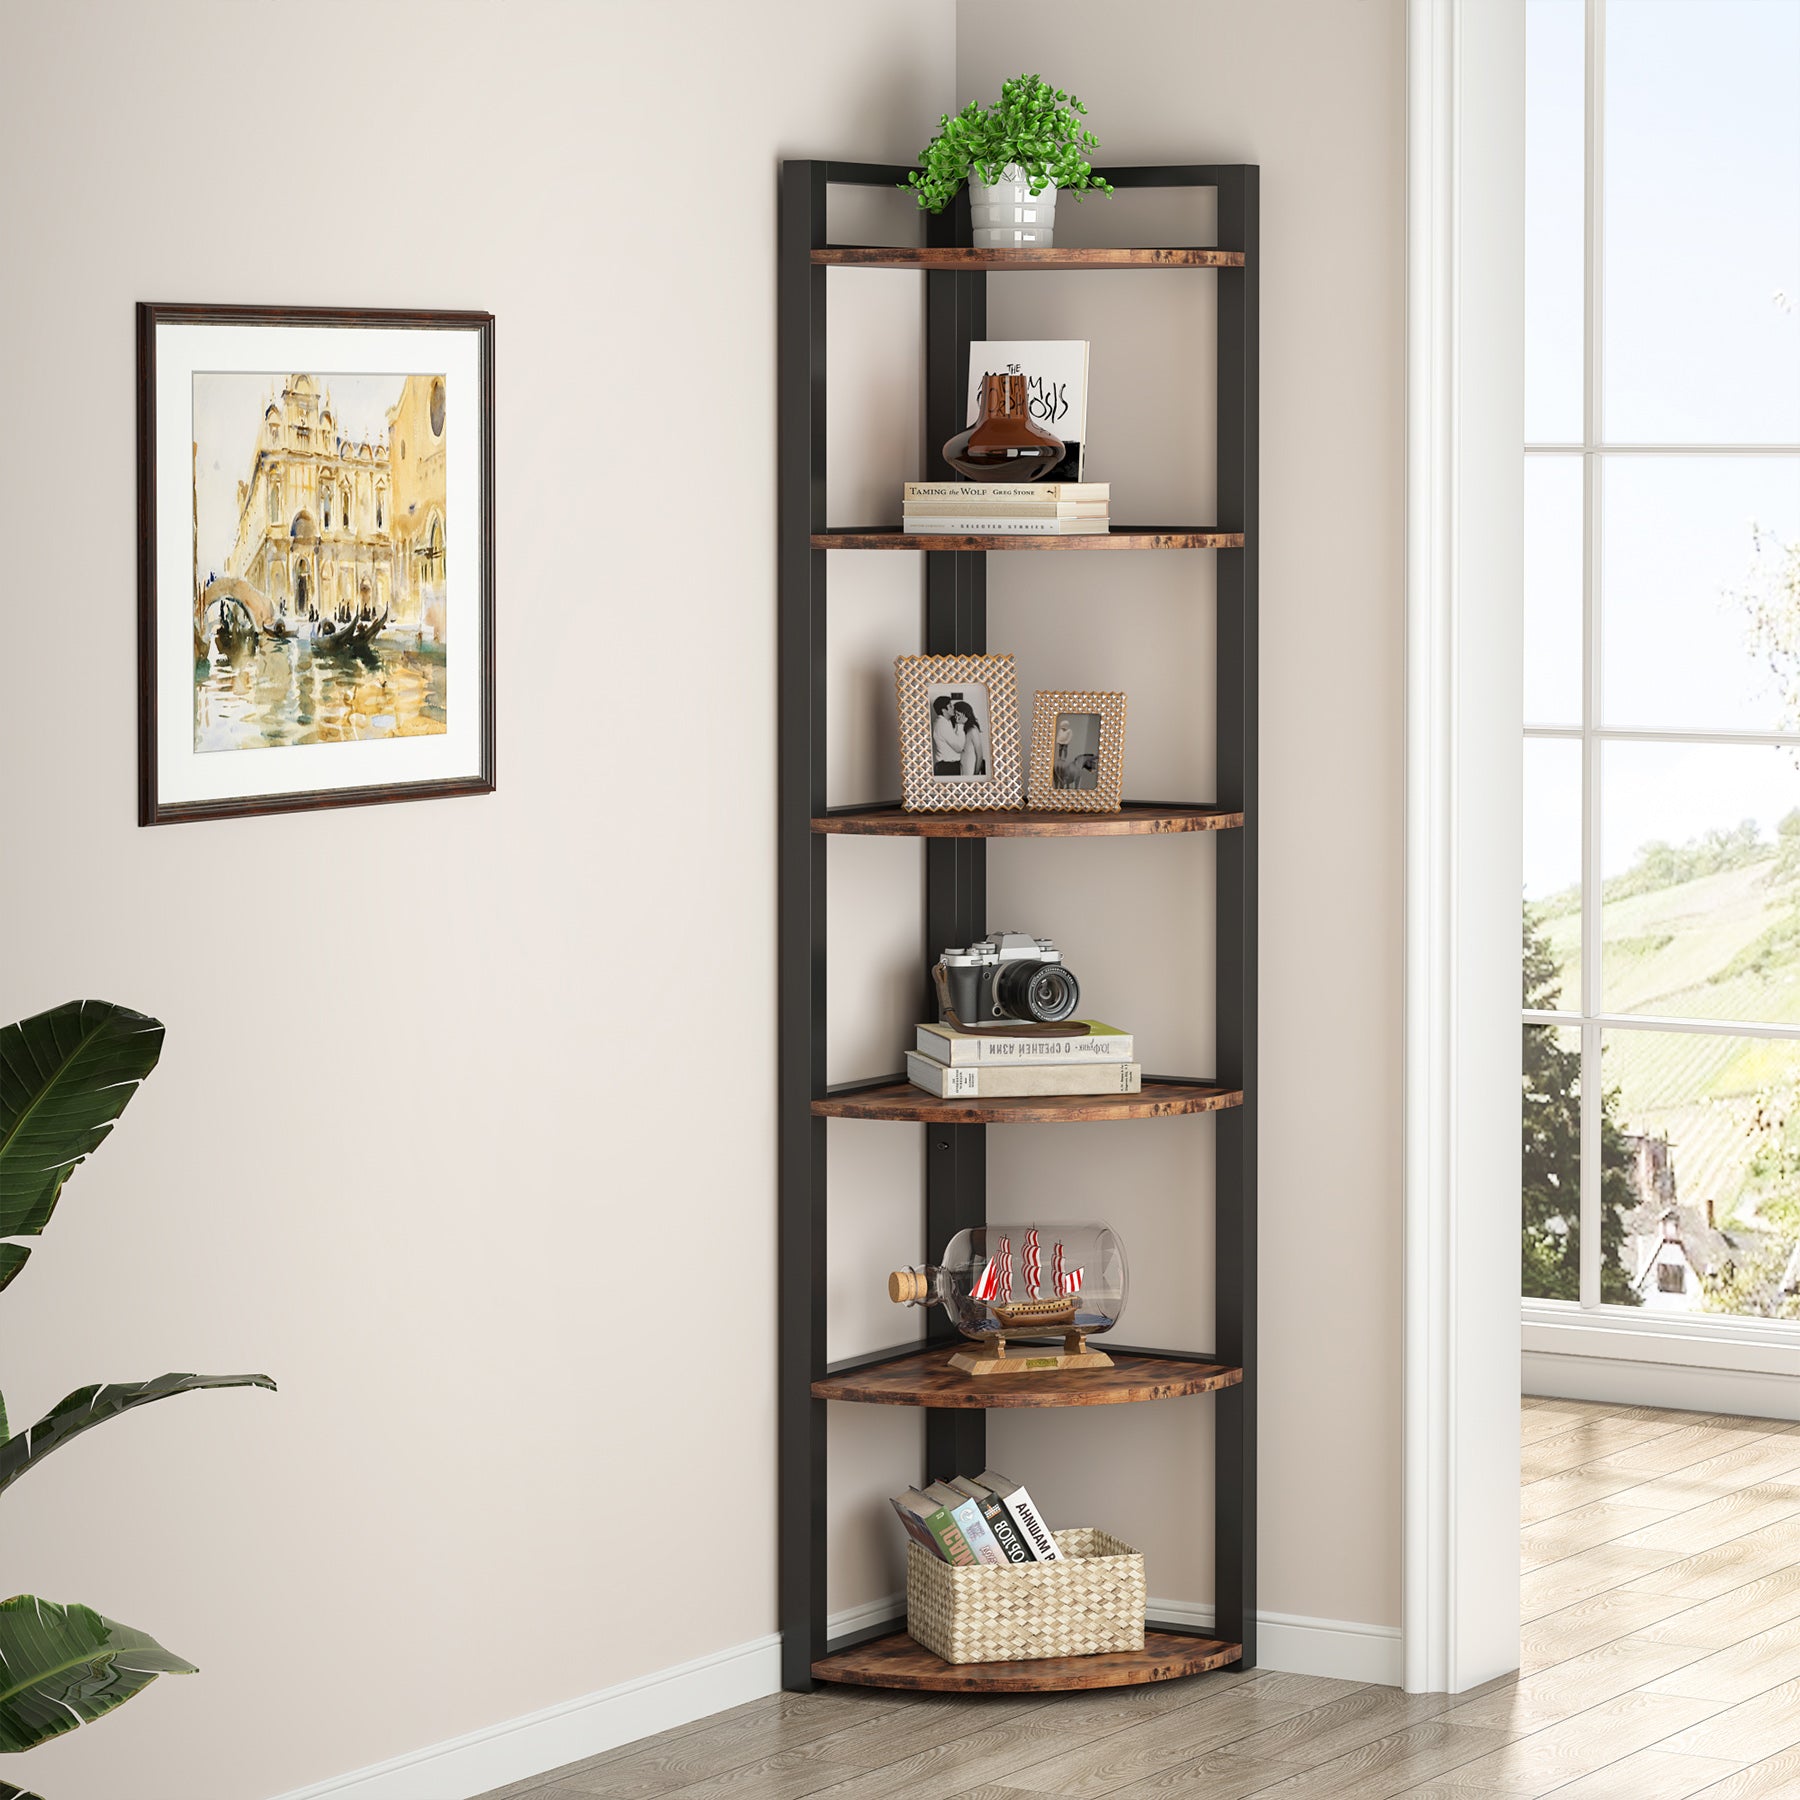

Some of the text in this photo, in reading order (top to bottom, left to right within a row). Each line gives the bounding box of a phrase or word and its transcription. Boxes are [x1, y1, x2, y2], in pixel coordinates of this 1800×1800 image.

[1006, 363, 1021, 375] THE
[909, 487, 1035, 496] TAMING the WOLF GREG STONE
